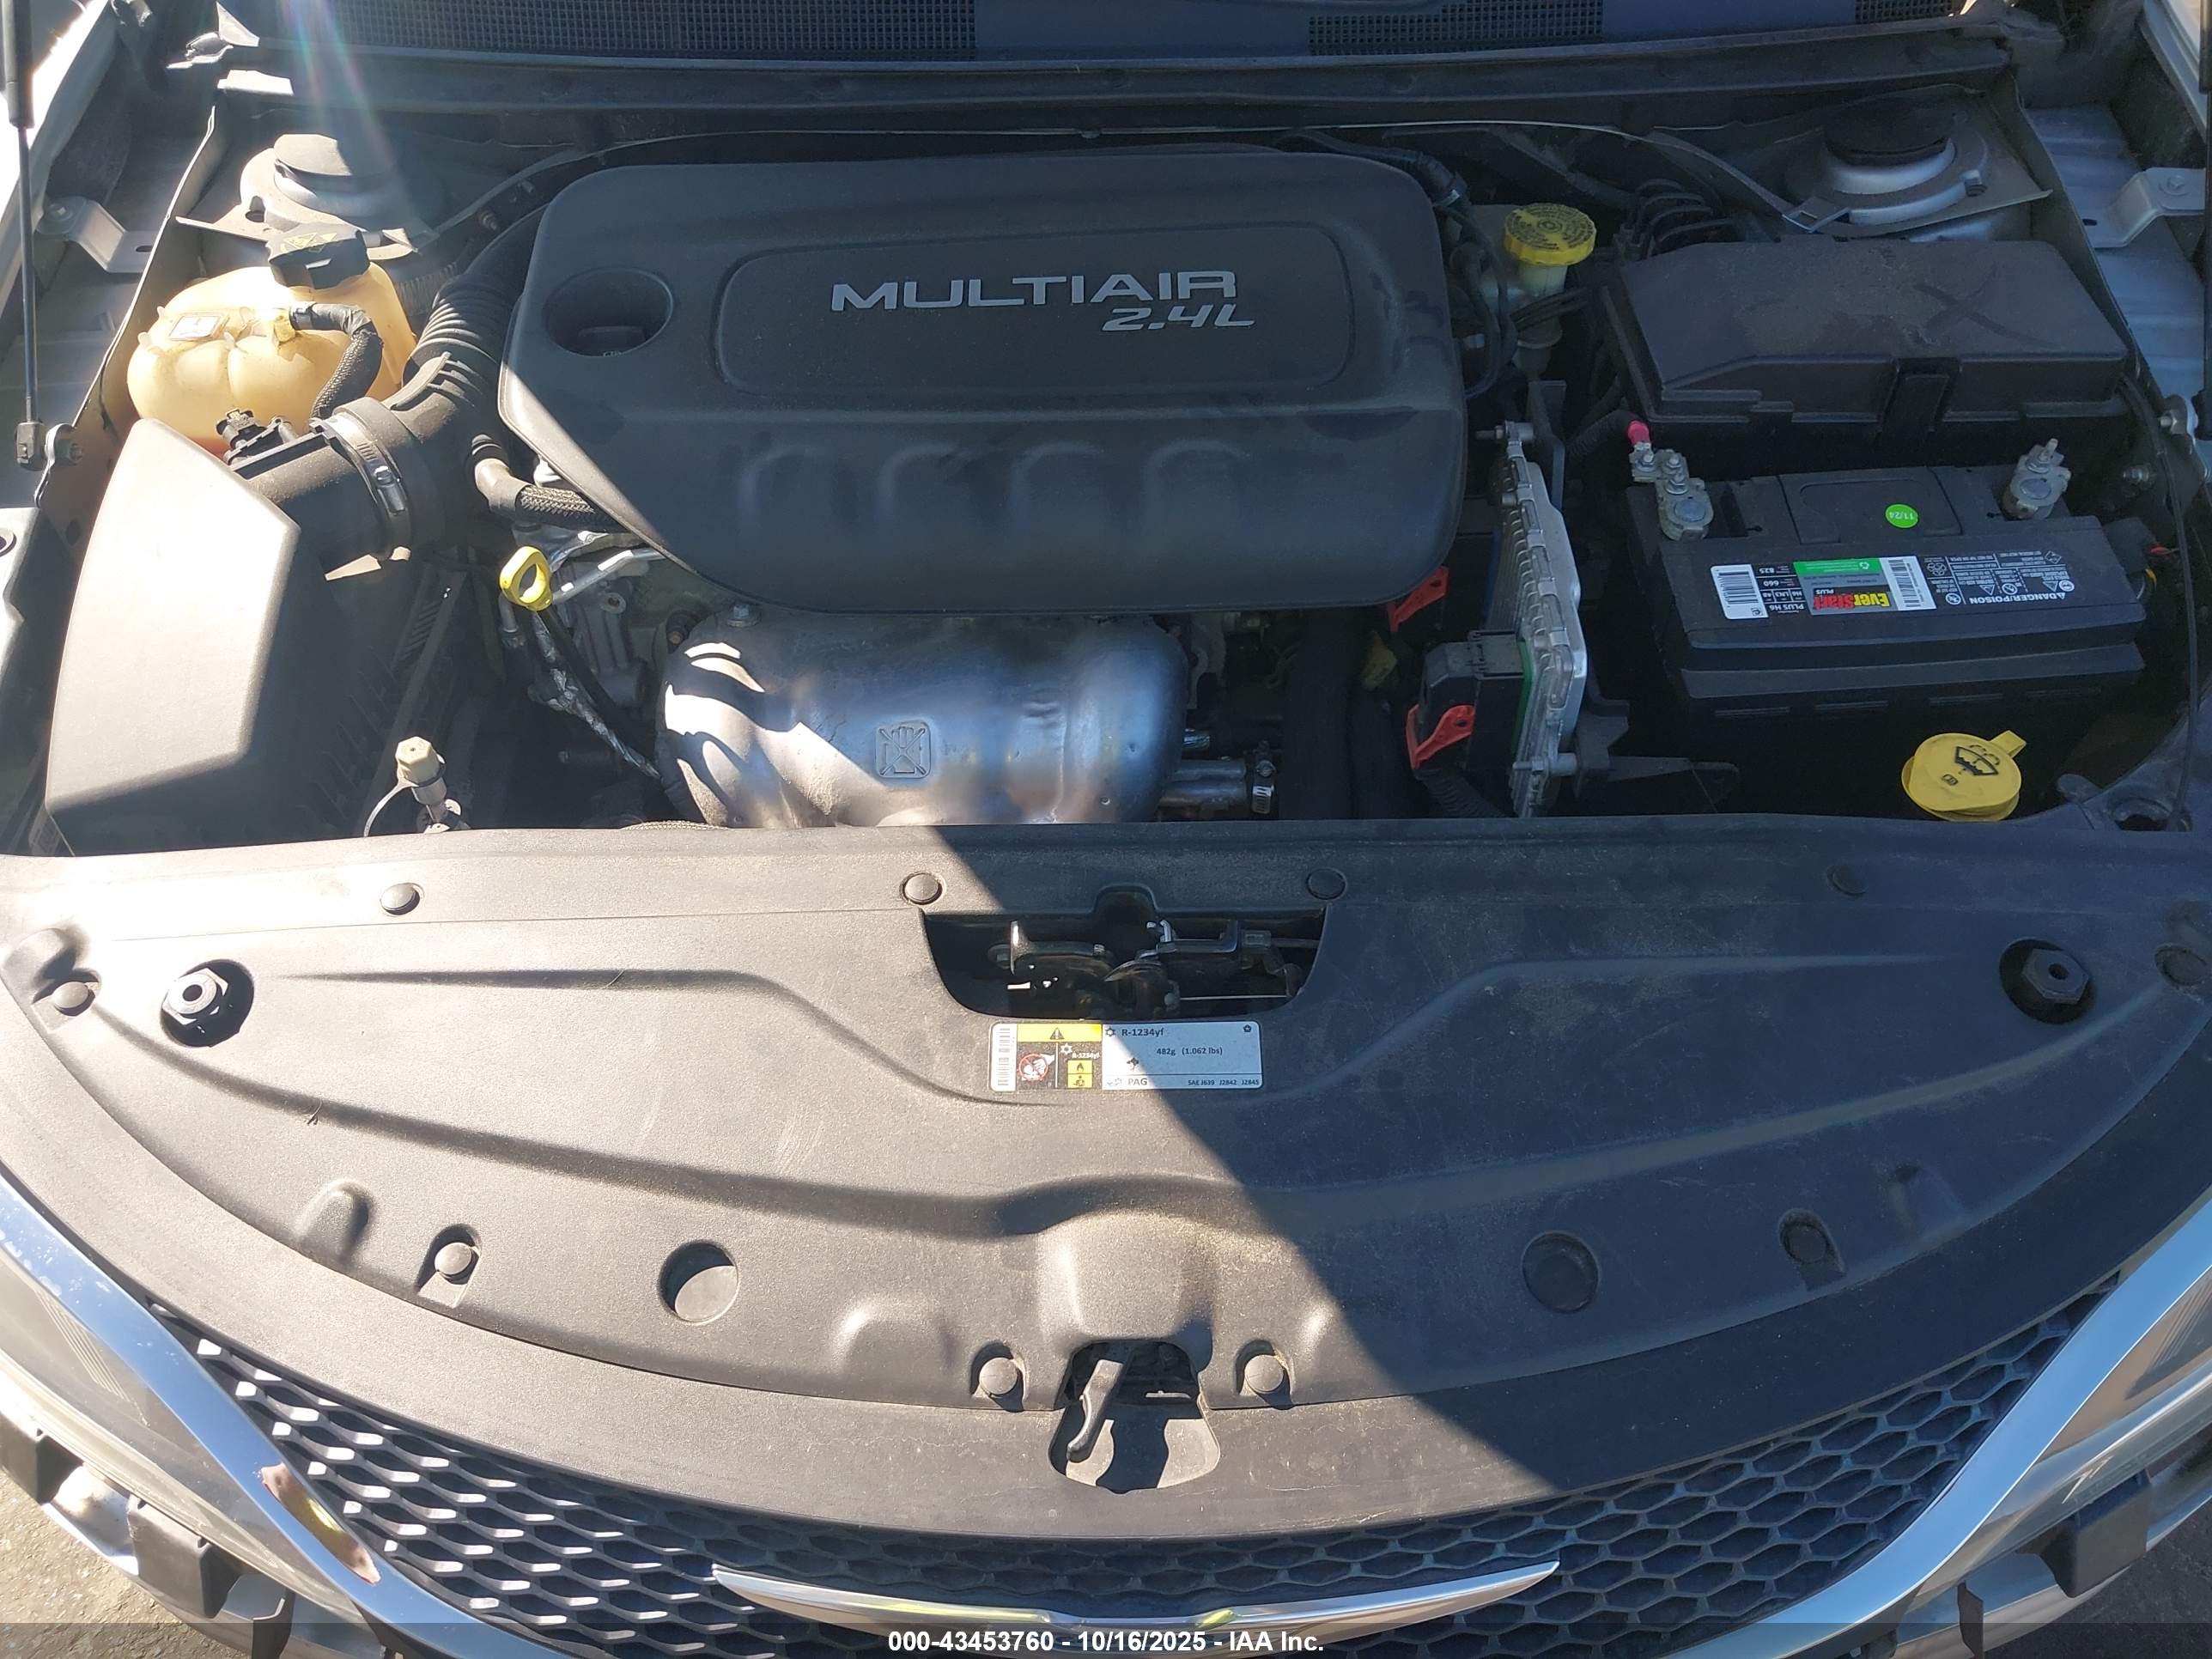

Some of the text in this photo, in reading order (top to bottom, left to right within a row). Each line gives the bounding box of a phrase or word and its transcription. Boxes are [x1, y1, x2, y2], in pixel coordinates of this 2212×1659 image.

[830, 270, 1237, 312] MULTIAIR
[1101, 302, 1255, 332] 2.4L
[1813, 592, 1890, 610] EverStart
[1969, 592, 2057, 605] DANGER/POISON
[1121, 1028, 1164, 1037] R-1234yf
[1157, 1047, 1223, 1056] 482g (1.062 lbs)
[1127, 1078, 1148, 1086] PAG
